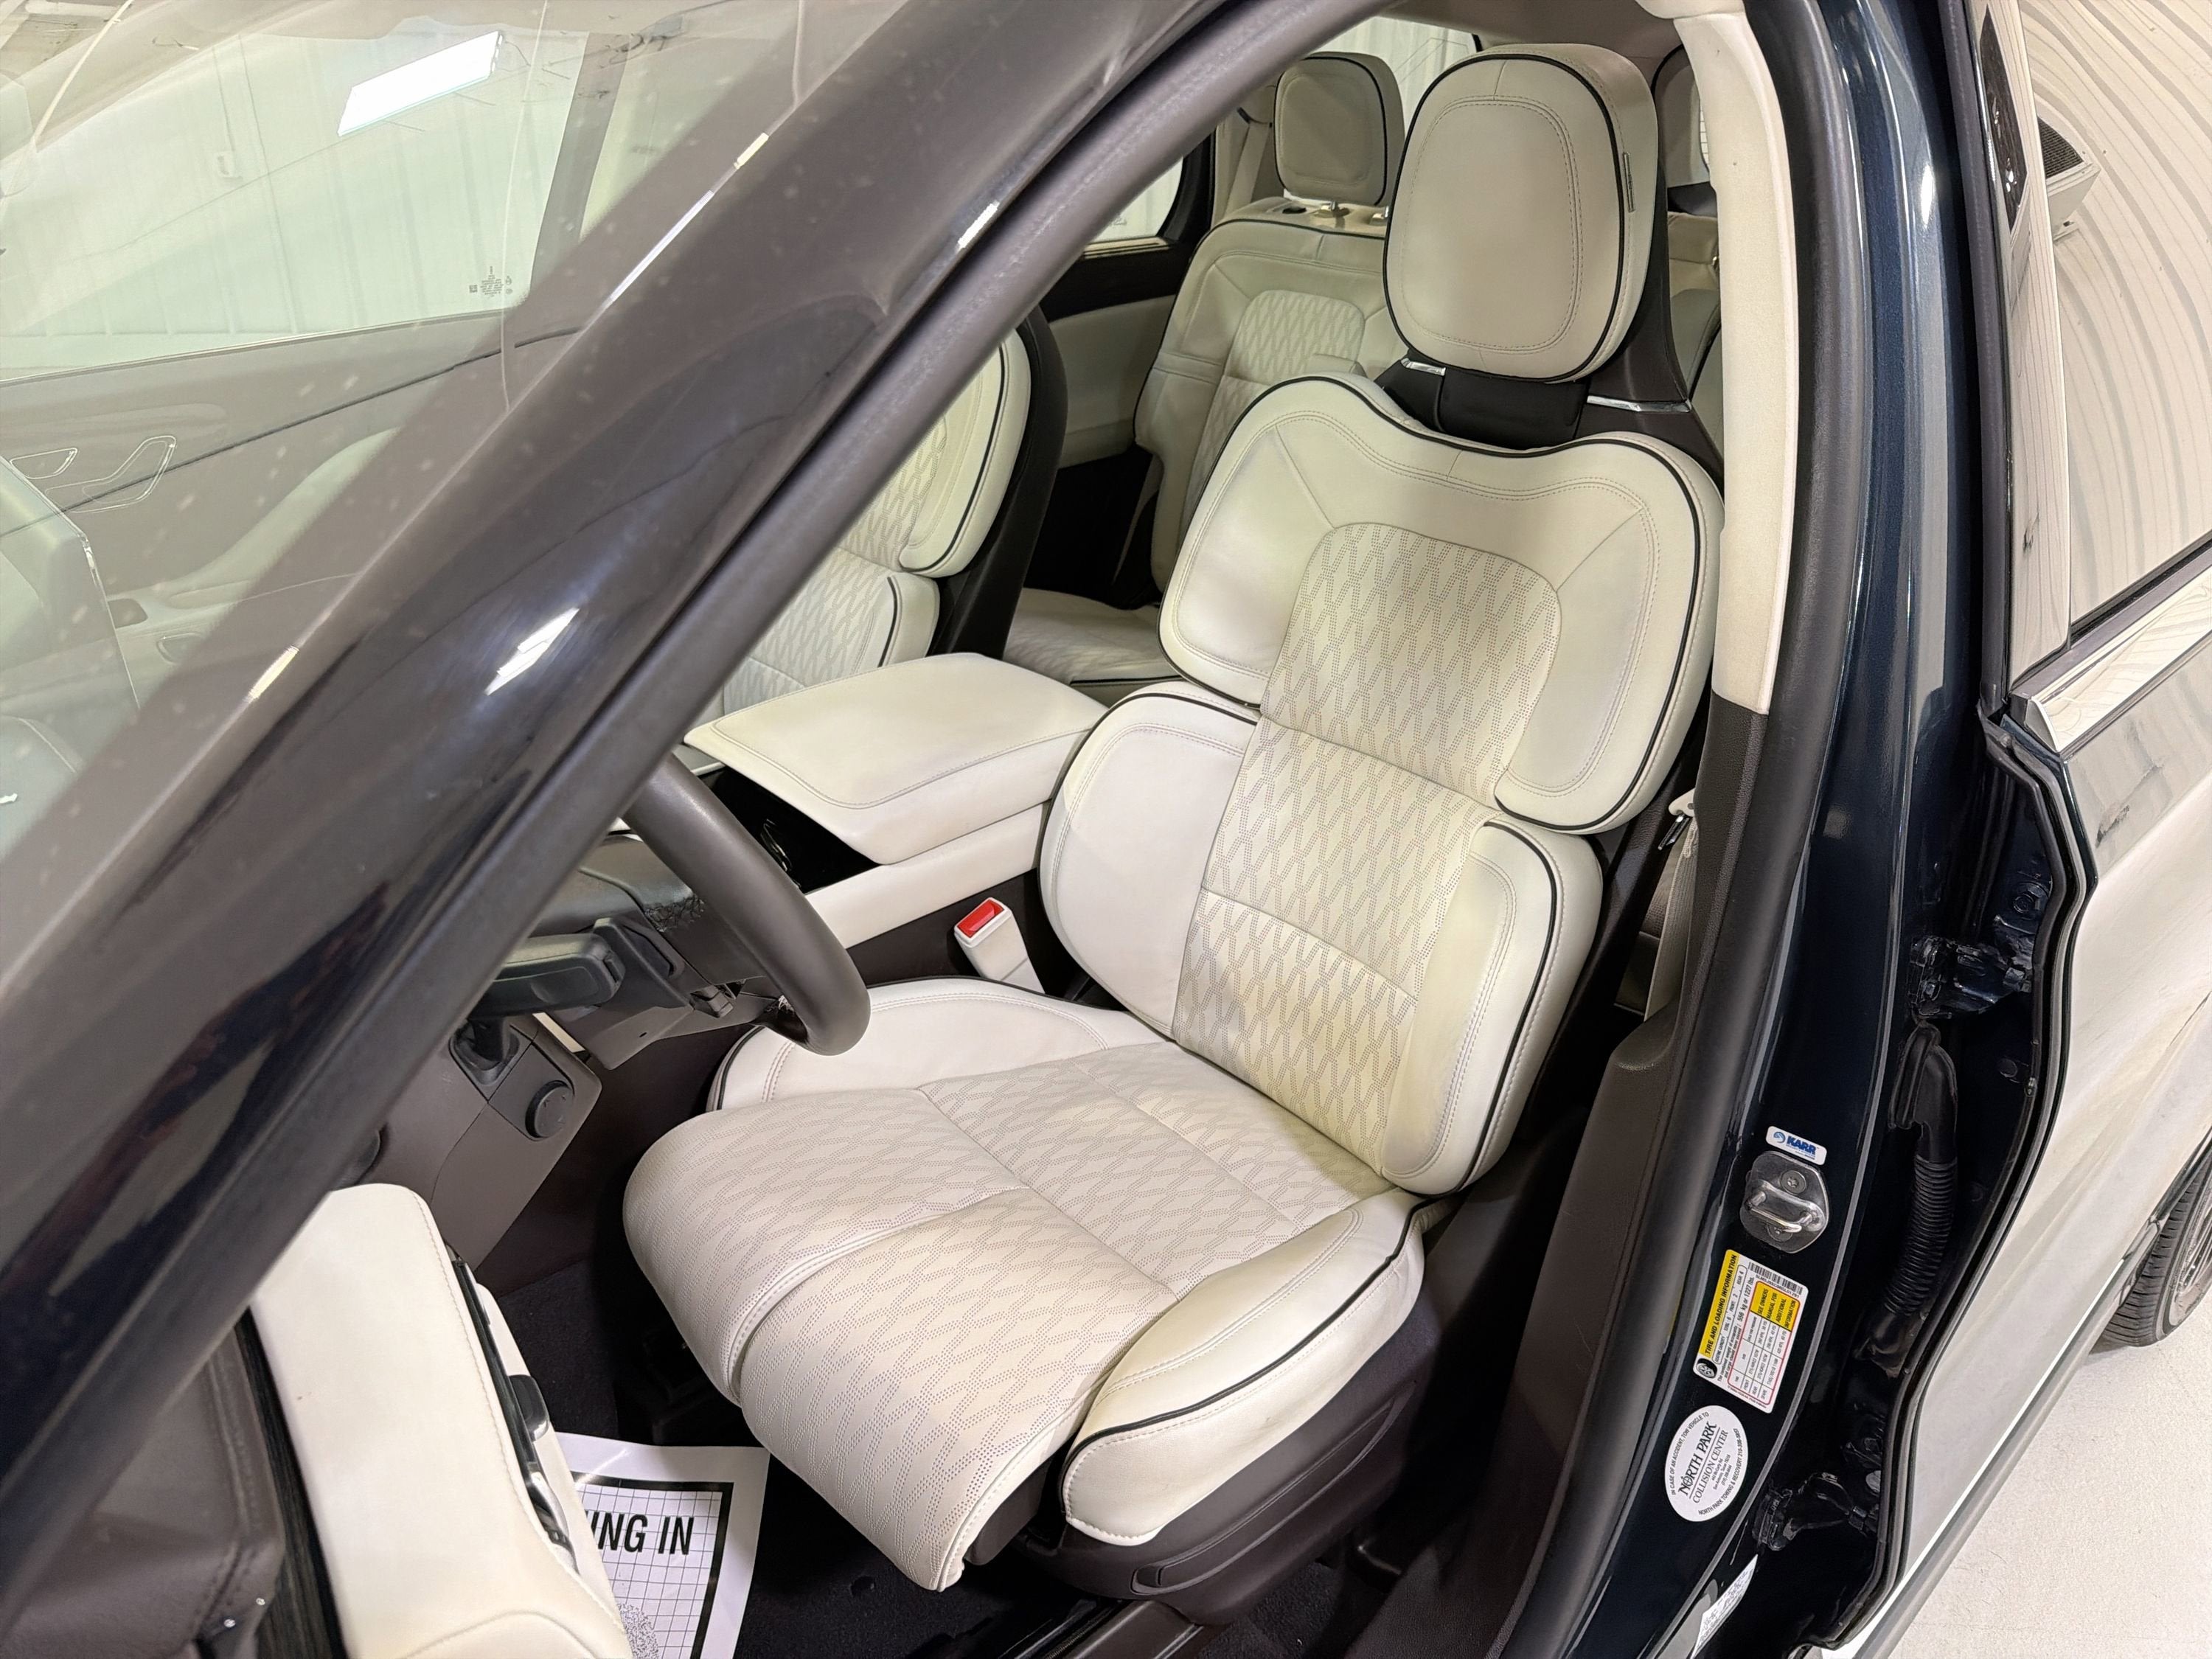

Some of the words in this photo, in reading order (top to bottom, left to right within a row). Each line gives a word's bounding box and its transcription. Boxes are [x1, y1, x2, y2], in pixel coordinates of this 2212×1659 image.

[1787, 1135, 1816, 1156] KARR
[1714, 1297, 1725, 1325] LOADING
[1722, 1253, 1737, 1297] INFORMATION
[1741, 1303, 1747, 1311] kg
[1744, 1284, 1752, 1297] 1227
[1775, 1298, 1786, 1322] ADDITIONAL
[1784, 1299, 1796, 1328] INFORMATION
[1672, 1438, 1685, 1460] ACCIDENT,
[1681, 1428, 1689, 1438] TOW
[1688, 1415, 1703, 1429] VEHICLE
[1678, 1453, 1703, 1495] NORTH
[1696, 1421, 1717, 1454] PARK
[1693, 1461, 1715, 1503] COLLISION
[1711, 1430, 1728, 1461] CENTER
[1698, 1506, 1714, 1514] NORTH
[1713, 1498, 1722, 1509] PARK
[1721, 1484, 1733, 1500] TOWING
[1733, 1456, 1742, 1481] RECOVERY
[585, 1509, 648, 1553] ING
[658, 1515, 695, 1555] IN
